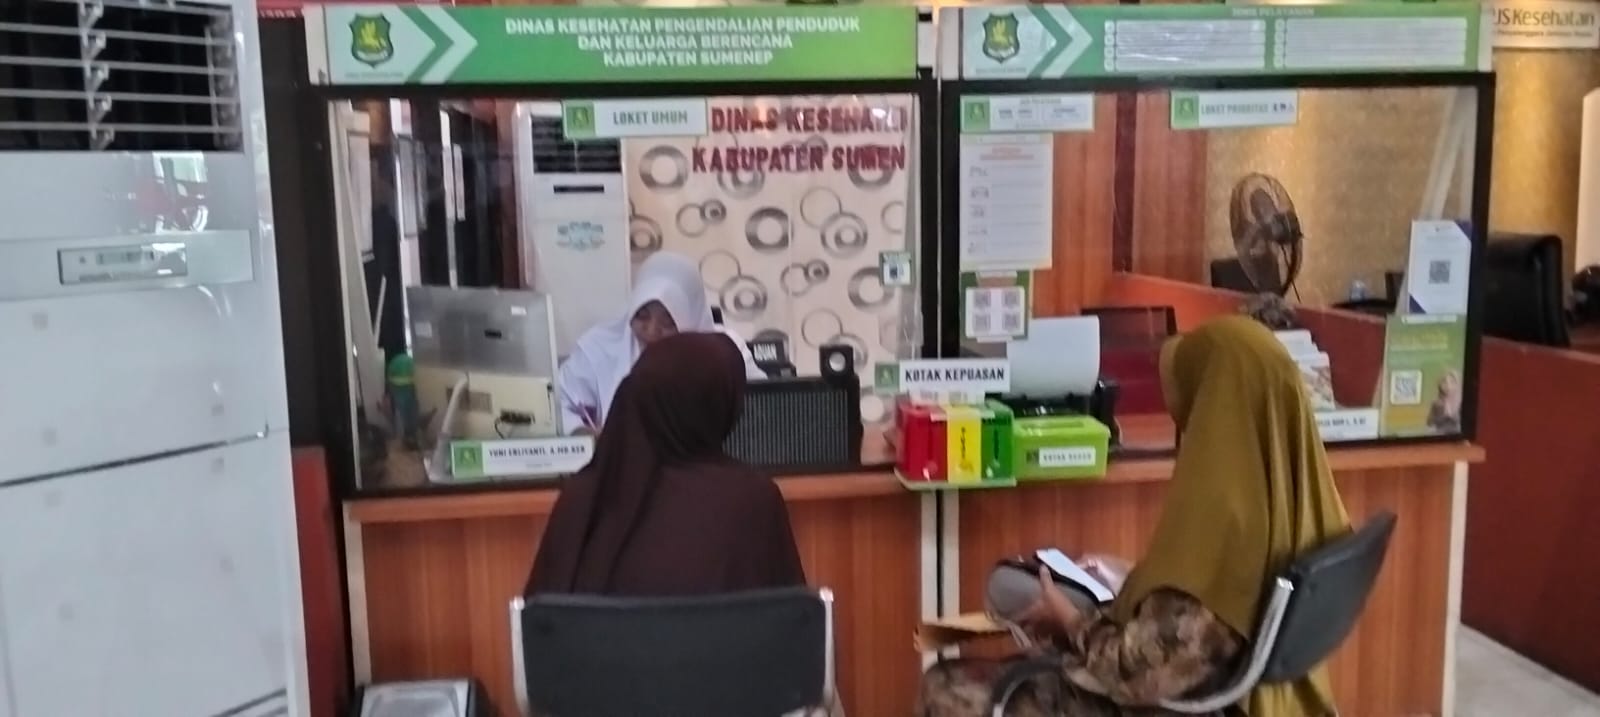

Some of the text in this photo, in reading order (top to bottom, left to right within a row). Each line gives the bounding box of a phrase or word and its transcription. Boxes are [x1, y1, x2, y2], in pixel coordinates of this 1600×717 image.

[504, 16, 861, 35] DINAS KESEHATAN PENGENDALIAN PENDUDUK
[1513, 8, 1595, 26] Kesehatan
[578, 33, 793, 50] DAN KELUARGA BERENCANA
[603, 50, 774, 67] KABUPATEN SUMENEP
[612, 109, 688, 125] LOKET UMUM
[711, 106, 779, 133] DINAS
[692, 146, 826, 173] KABUPATEN
[904, 367, 1005, 382] KOTAK KEPUASAN
